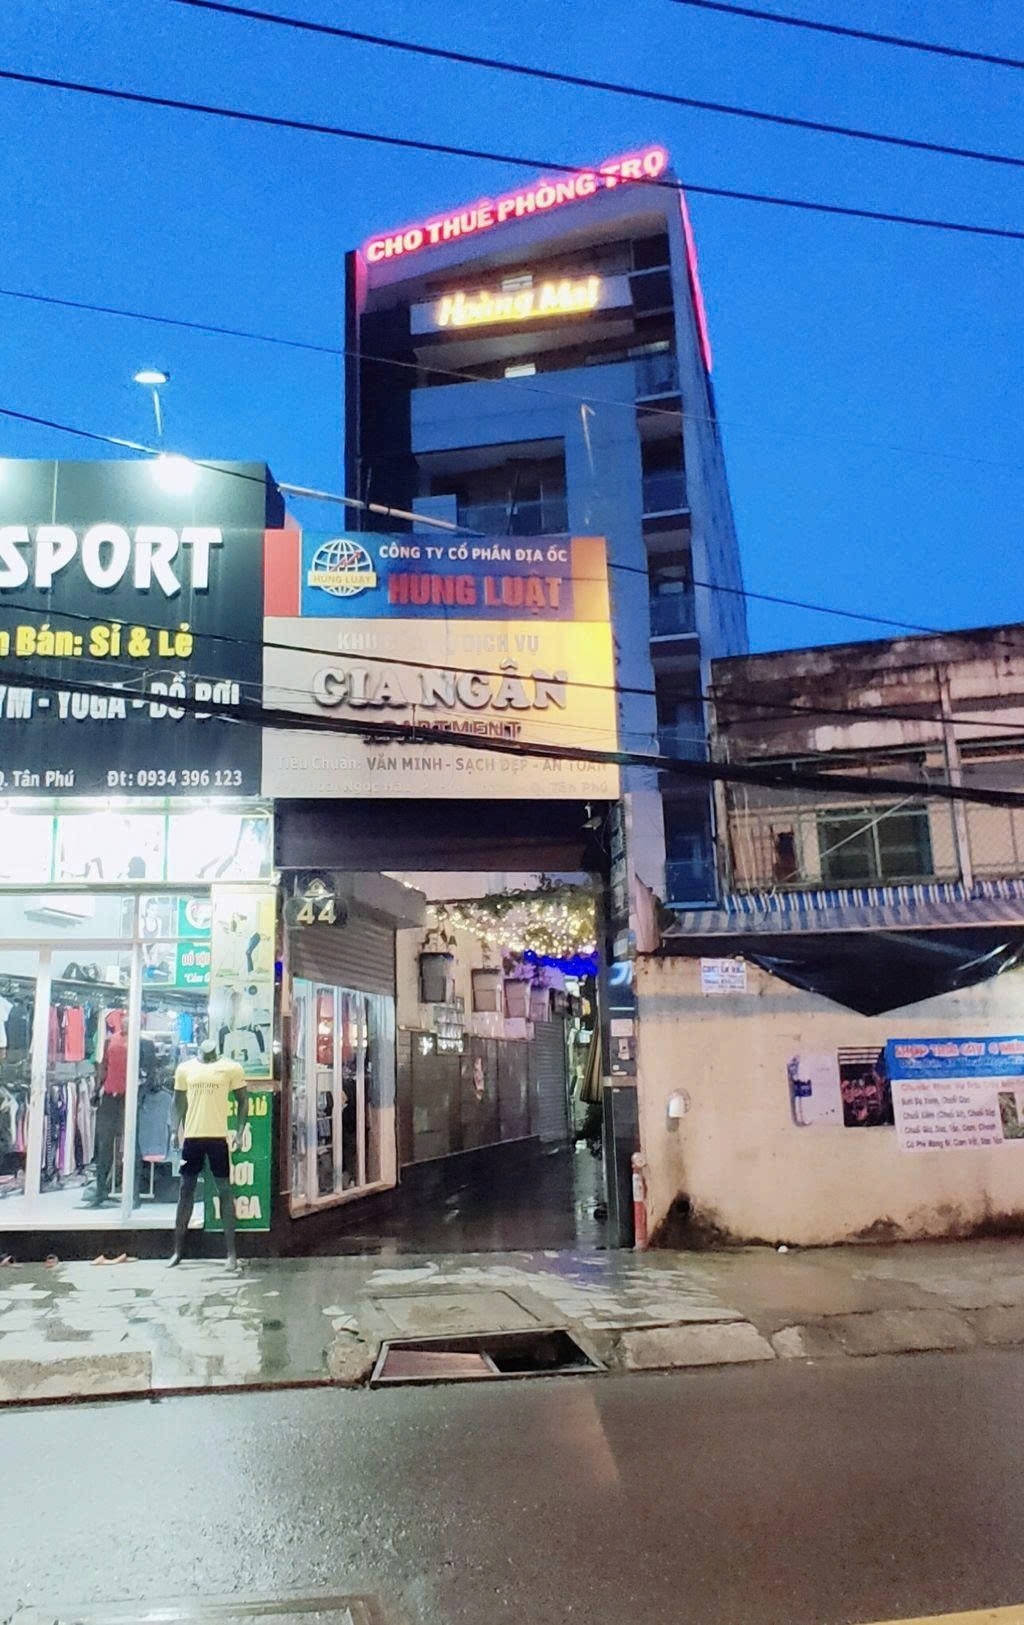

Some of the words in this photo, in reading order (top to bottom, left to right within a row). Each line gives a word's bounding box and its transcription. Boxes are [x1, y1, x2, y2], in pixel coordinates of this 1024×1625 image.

[366, 229, 424, 261] CHO
[425, 202, 495, 244] THUÊ
[496, 172, 596, 222] PHÒNG
[0, 522, 223, 598] SPORT
[378, 541, 422, 560] CÔNG
[426, 547, 445, 560] TY
[515, 548, 544, 565] ĐỊA
[15, 624, 83, 658] Bán:
[127, 626, 152, 658] &
[311, 666, 414, 711] GIA
[417, 656, 568, 711] NGÂN
[13, 769, 40, 788] Tân
[46, 768, 75, 788] Phú
[137, 769, 177, 788] 0934
[181, 769, 210, 788] 396
[214, 769, 243, 788] 123
[366, 752, 398, 771] VĂN
[402, 756, 443, 772] MINH
[542, 758, 562, 773] AN
[296, 897, 337, 925] 44
